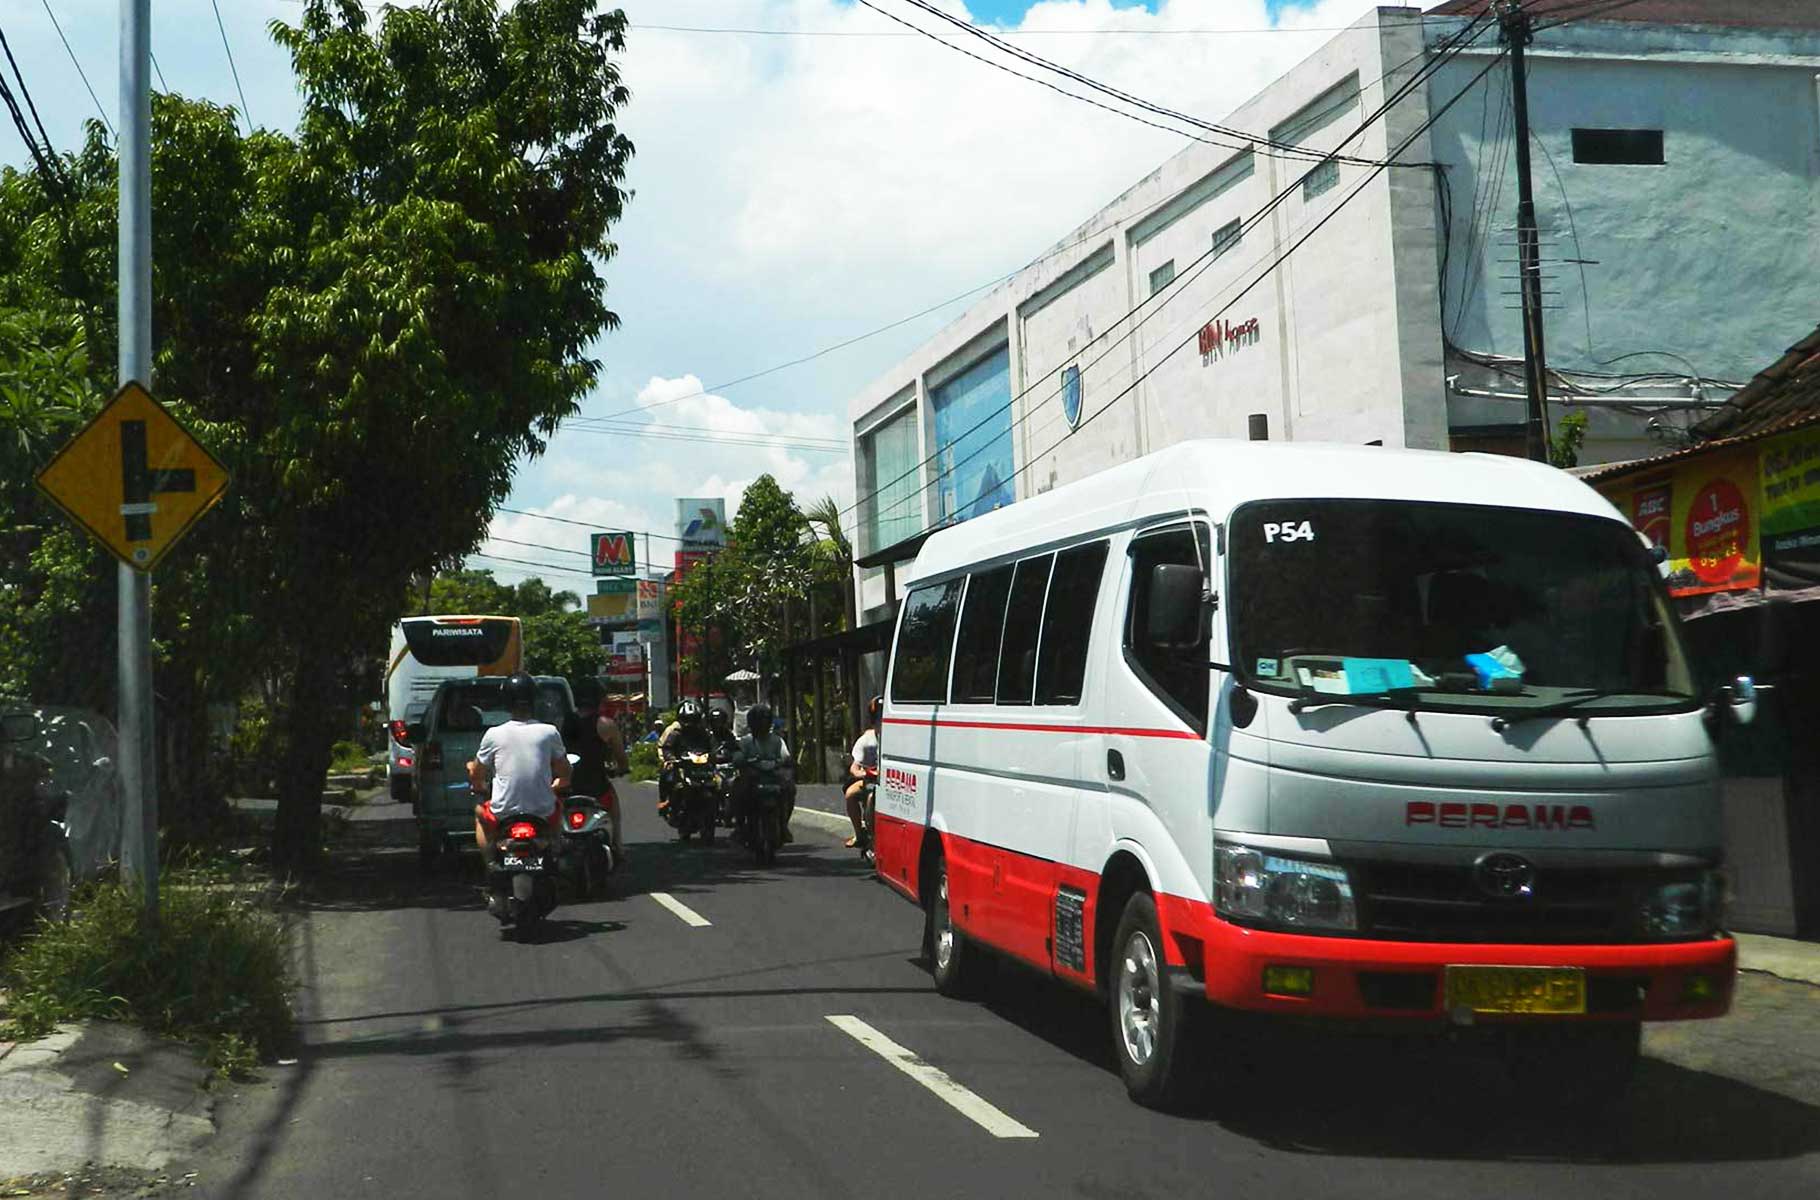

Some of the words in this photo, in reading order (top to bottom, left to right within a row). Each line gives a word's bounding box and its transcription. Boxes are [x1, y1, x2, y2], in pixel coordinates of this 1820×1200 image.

[1263, 520, 1315, 543] P54
[432, 628, 483, 637] PARIWISATA
[1406, 801, 1597, 831] PERAMA
